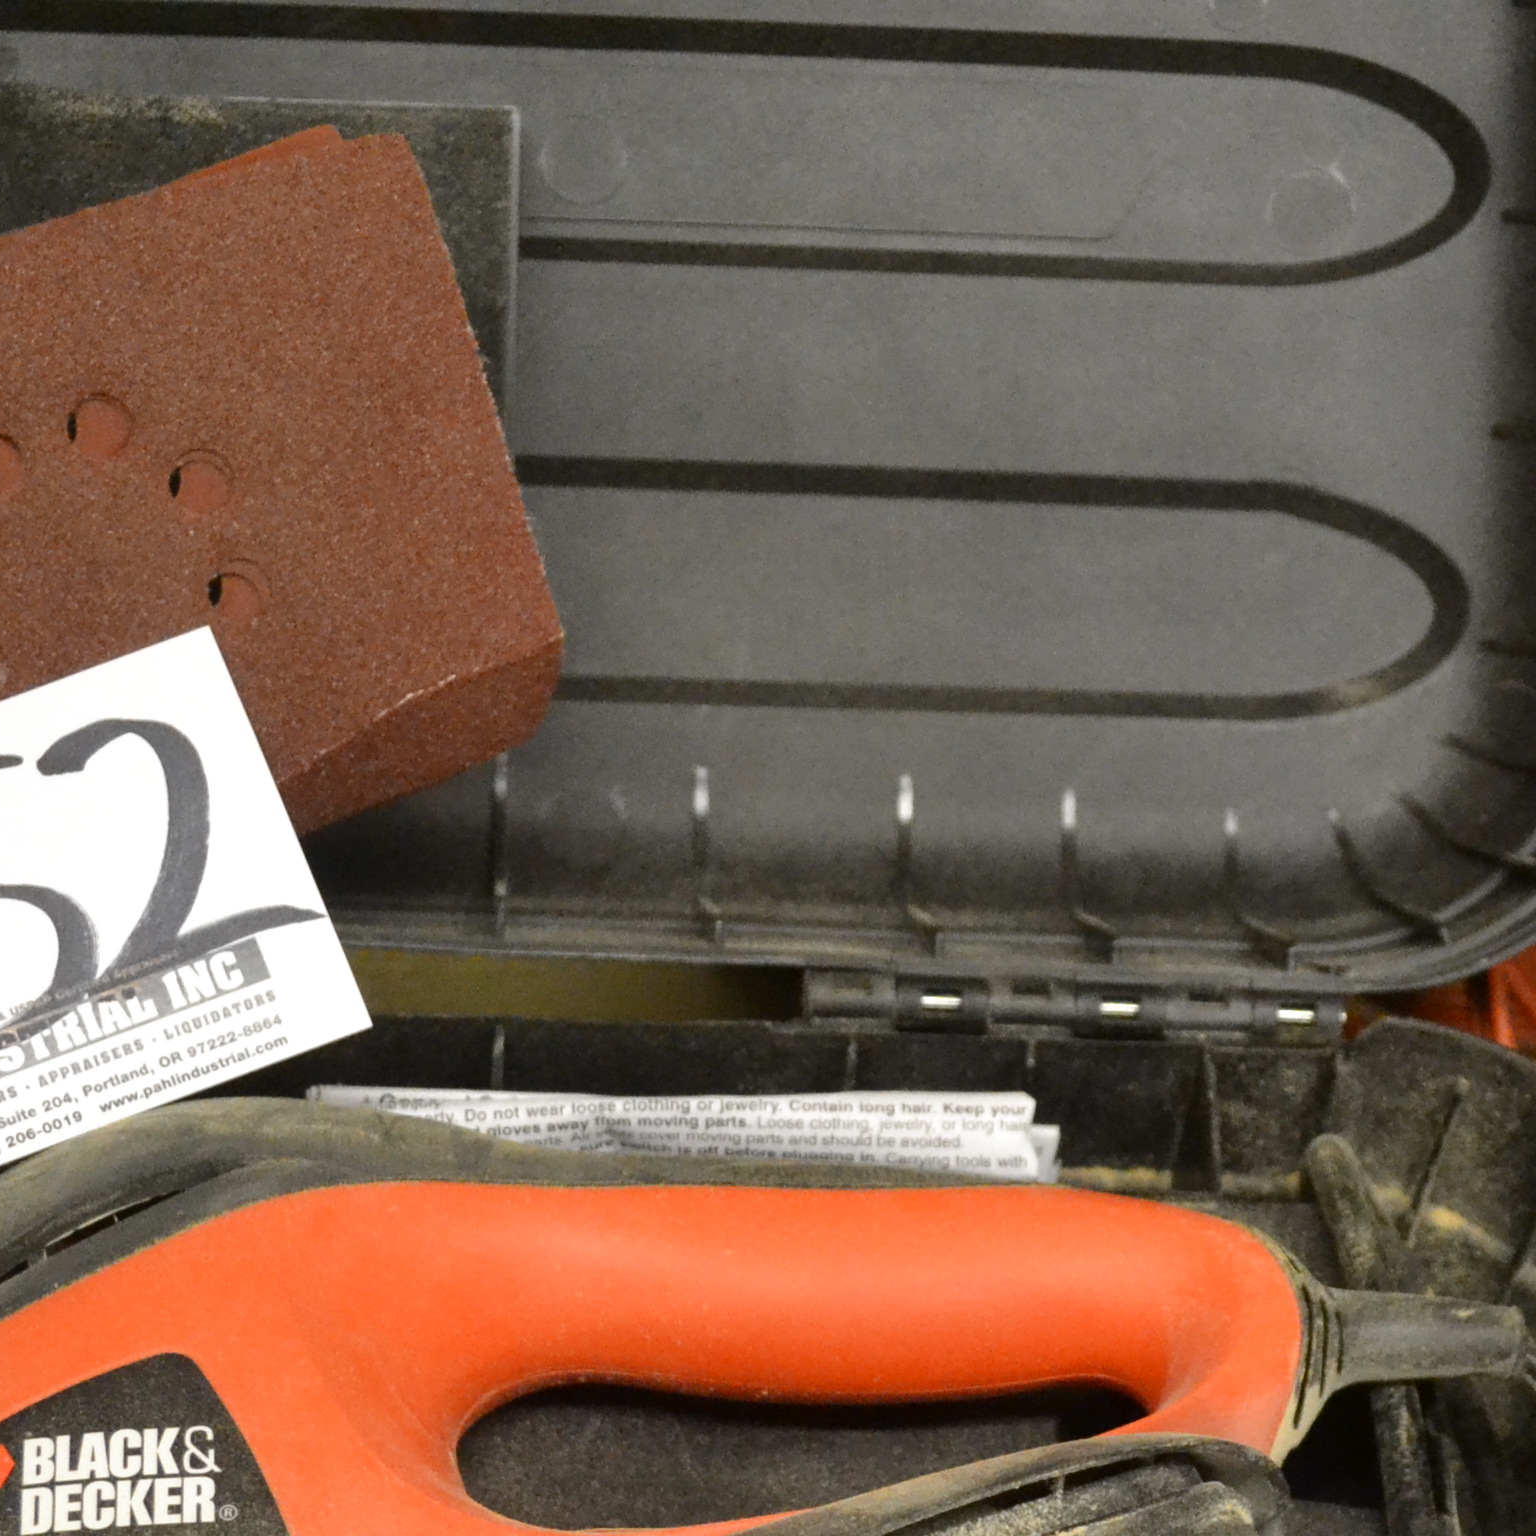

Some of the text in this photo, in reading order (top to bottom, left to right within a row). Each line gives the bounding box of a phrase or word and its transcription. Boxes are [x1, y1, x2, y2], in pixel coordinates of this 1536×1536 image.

[161, 950, 245, 1010] INC
[37, 1038, 145, 1088] APPRAISERS
[163, 989, 277, 1041] LIQUIDATORS
[41, 1091, 80, 1113] 204,
[82, 1063, 156, 1098] Portland,
[158, 1050, 184, 1069] OR
[187, 1014, 283, 1058] 97222-8864
[5, 1110, 83, 1149] 206-0019
[98, 1034, 289, 1115] www.pahlindustrial.com
[464, 1107, 487, 1121] Do
[493, 1106, 521, 1120] not
[526, 1105, 565, 1118] wear
[571, 1101, 617, 1116] loose
[622, 1099, 691, 1114] clothing
[697, 1101, 714, 1112] or
[788, 1100, 855, 1113] Contain
[859, 1101, 896, 1117] long
[943, 1102, 985, 1117] Keep
[990, 1104, 1028, 1118] your
[547, 1119, 589, 1133] away
[637, 1115, 700, 1130] moving
[757, 1116, 805, 1129] Loose
[962, 1119, 996, 1135] long
[686, 1130, 743, 1146] moving
[746, 1131, 785, 1147] parts
[788, 1133, 818, 1146] and
[822, 1133, 873, 1147] should
[877, 1134, 897, 1147] be
[19, 1476, 217, 1536] DECKER
